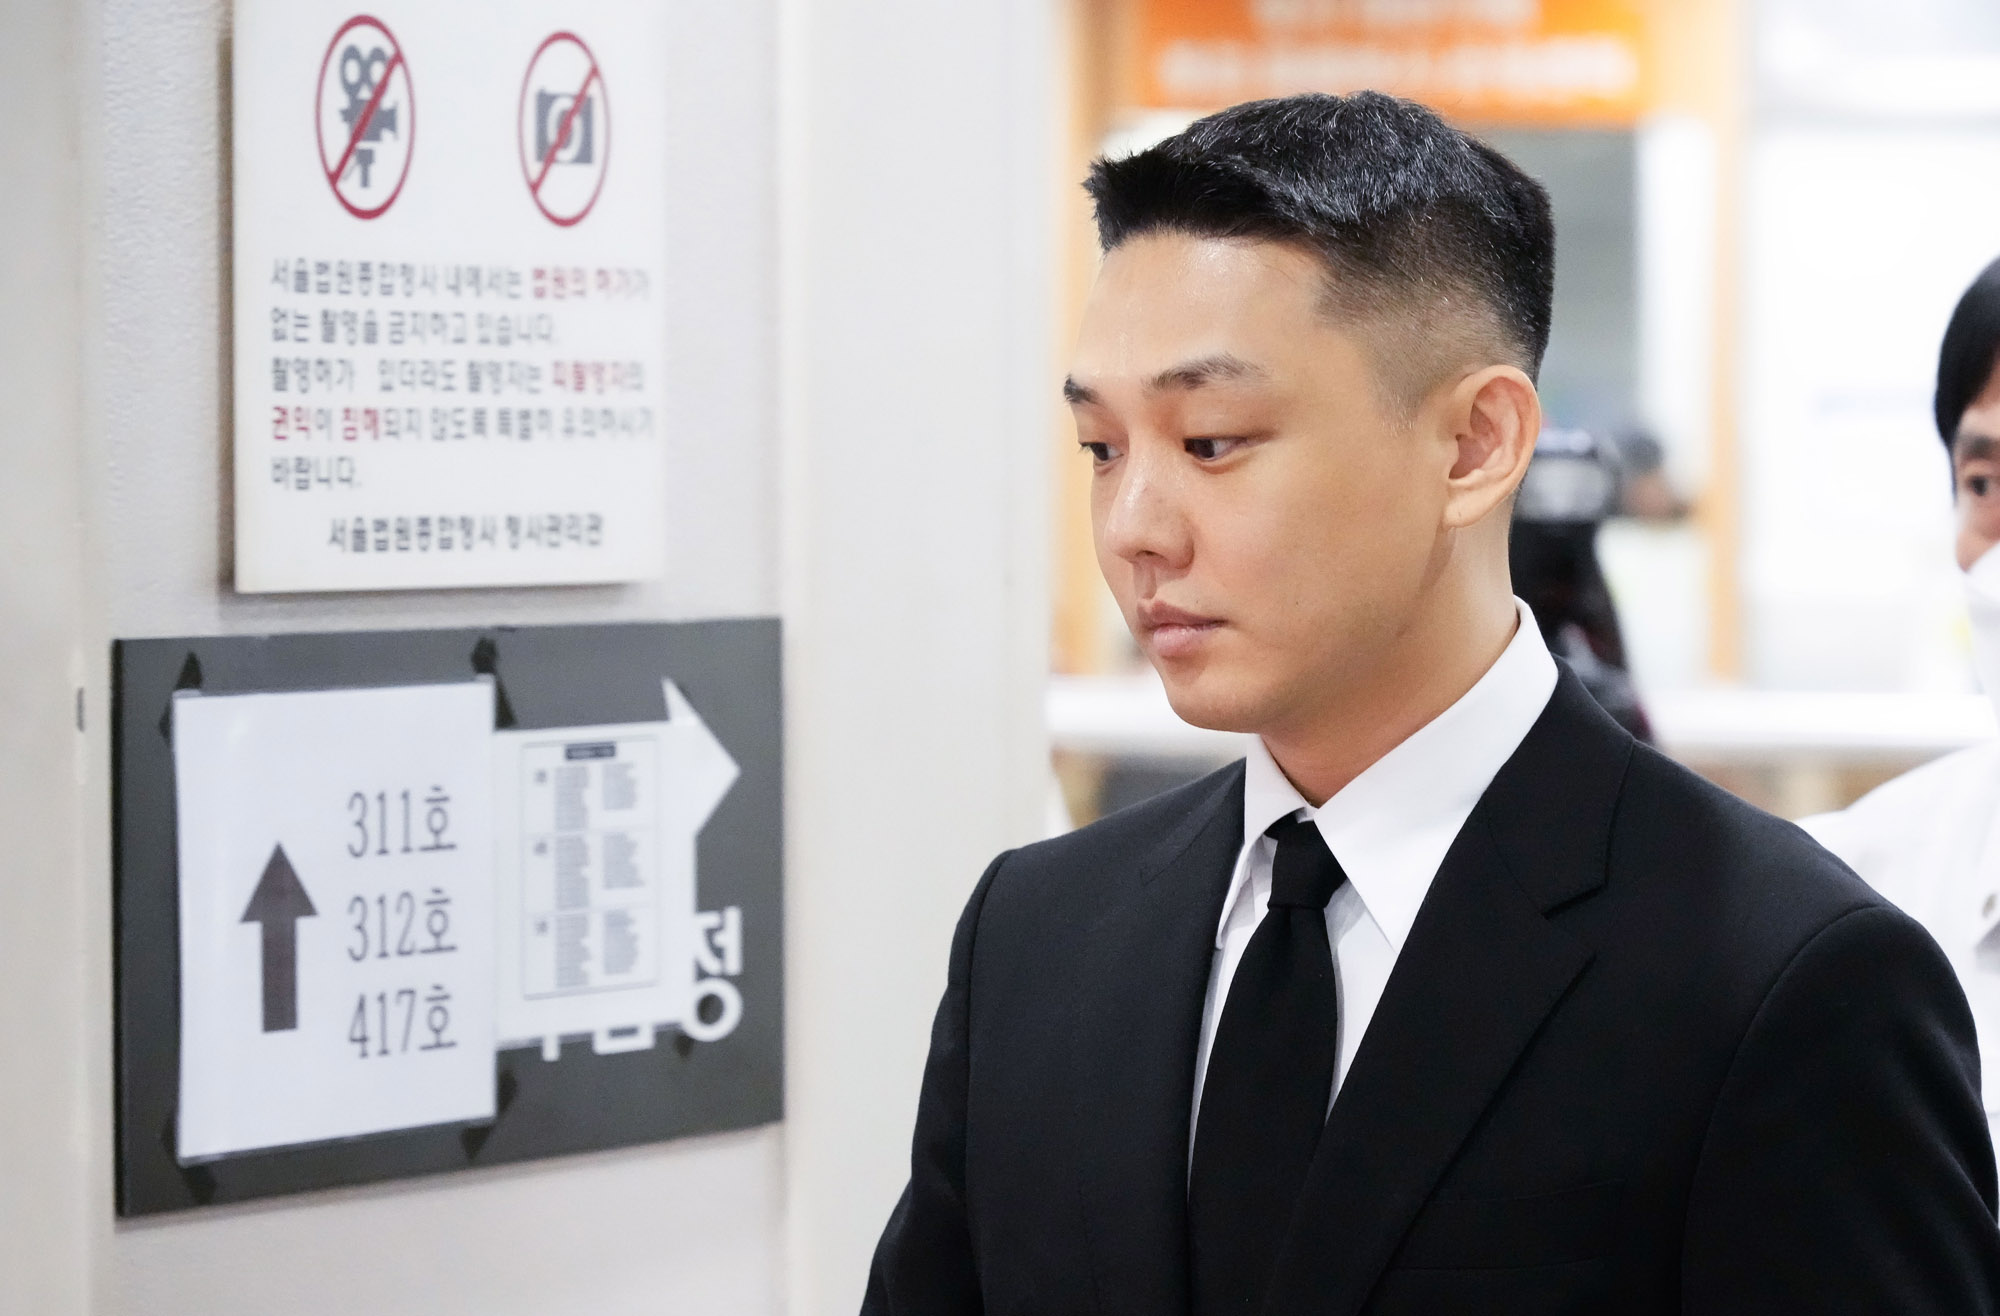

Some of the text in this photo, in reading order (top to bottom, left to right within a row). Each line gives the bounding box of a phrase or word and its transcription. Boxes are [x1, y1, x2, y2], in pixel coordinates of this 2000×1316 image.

[444, 264, 521, 299] 내에서는
[532, 267, 587, 300] 법원의
[271, 306, 309, 342] 없는
[321, 309, 379, 347] 촬영을
[389, 310, 467, 344] 금지하고
[272, 356, 354, 394] 촬영허가
[378, 358, 457, 393] 있더라도
[467, 360, 541, 394] 촬영자는
[273, 405, 332, 440] 권익이
[343, 406, 421, 441] 침해되지
[431, 407, 487, 441] 않도록
[497, 407, 553, 441] 특별히
[271, 456, 362, 490] 바랍니다.
[347, 785, 457, 858] 311호
[347, 887, 458, 962] 312호
[347, 984, 458, 1058] 417호
